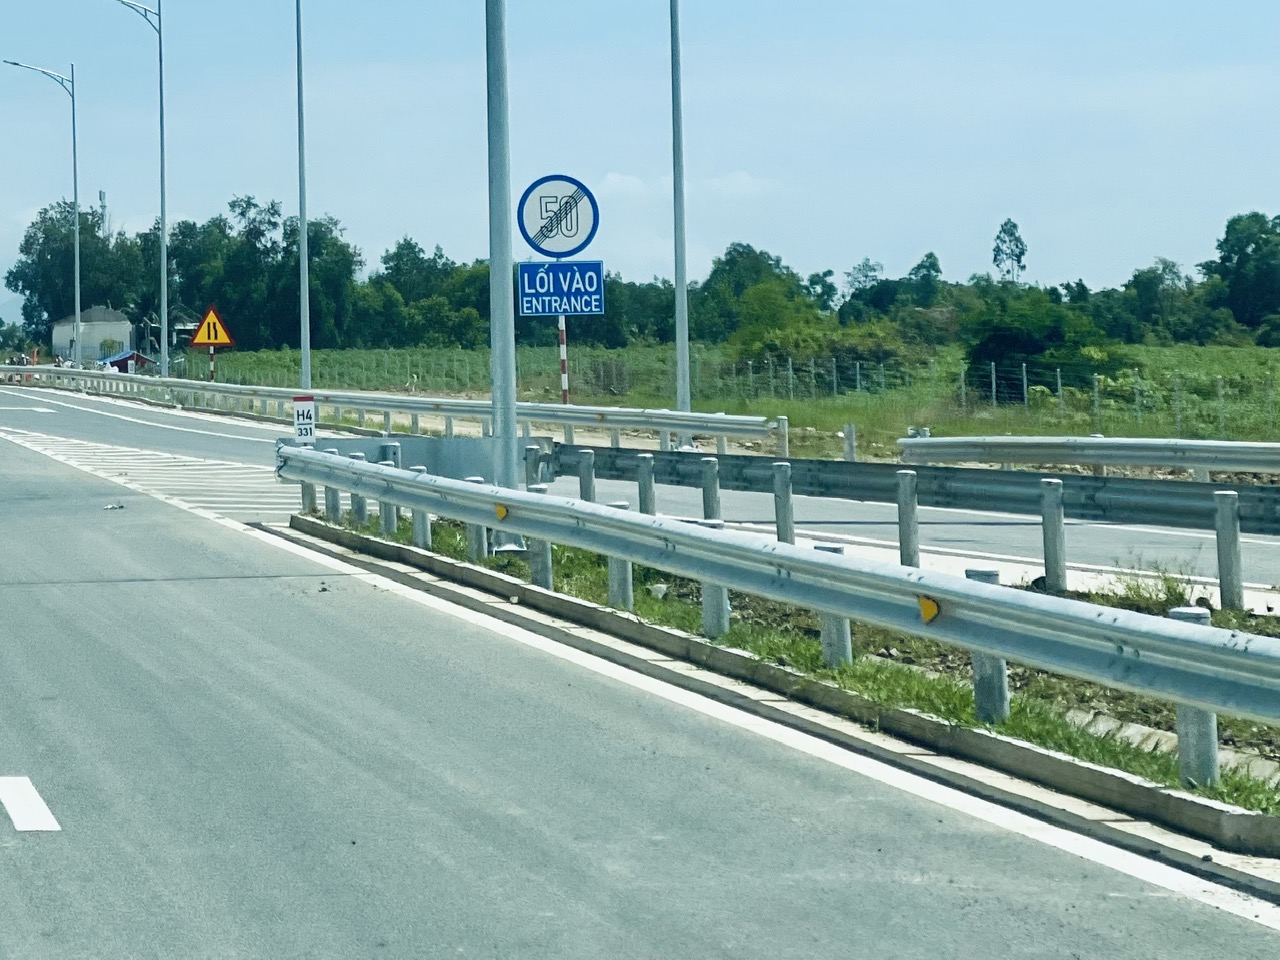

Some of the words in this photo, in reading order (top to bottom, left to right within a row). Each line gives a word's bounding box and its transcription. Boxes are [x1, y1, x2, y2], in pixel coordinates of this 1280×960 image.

[539, 195, 580, 239] 50
[523, 264, 554, 294] LỐI
[558, 266, 598, 293] VÀO
[522, 295, 601, 314] ENTRANCE
[296, 409, 313, 422] H4
[297, 427, 313, 437] 331
